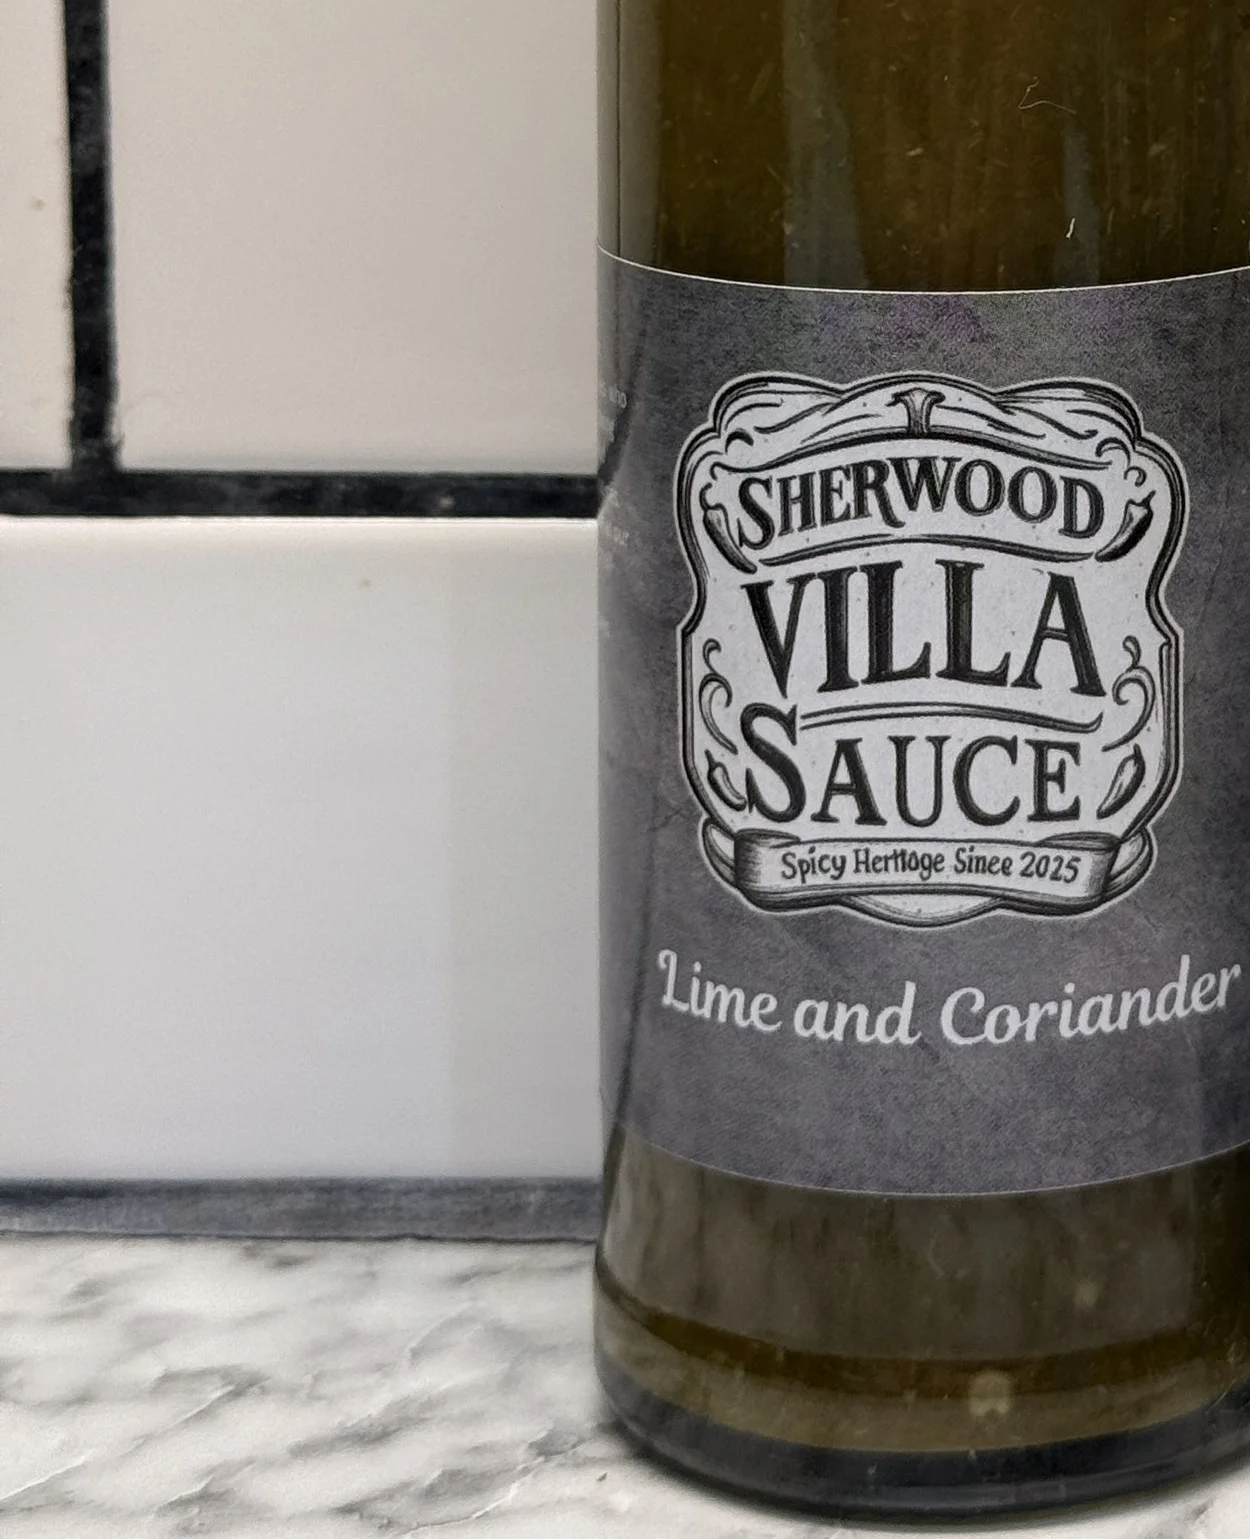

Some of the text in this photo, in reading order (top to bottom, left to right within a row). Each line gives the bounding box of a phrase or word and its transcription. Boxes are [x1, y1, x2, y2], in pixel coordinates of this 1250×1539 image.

[736, 456, 1104, 549] SHERWOOD
[740, 559, 1106, 700] VILLA
[740, 703, 1082, 828] SAUCE
[780, 846, 847, 883] Spicy
[1019, 851, 1081, 883] 2025
[657, 949, 1242, 1045] Lime and Coriander
